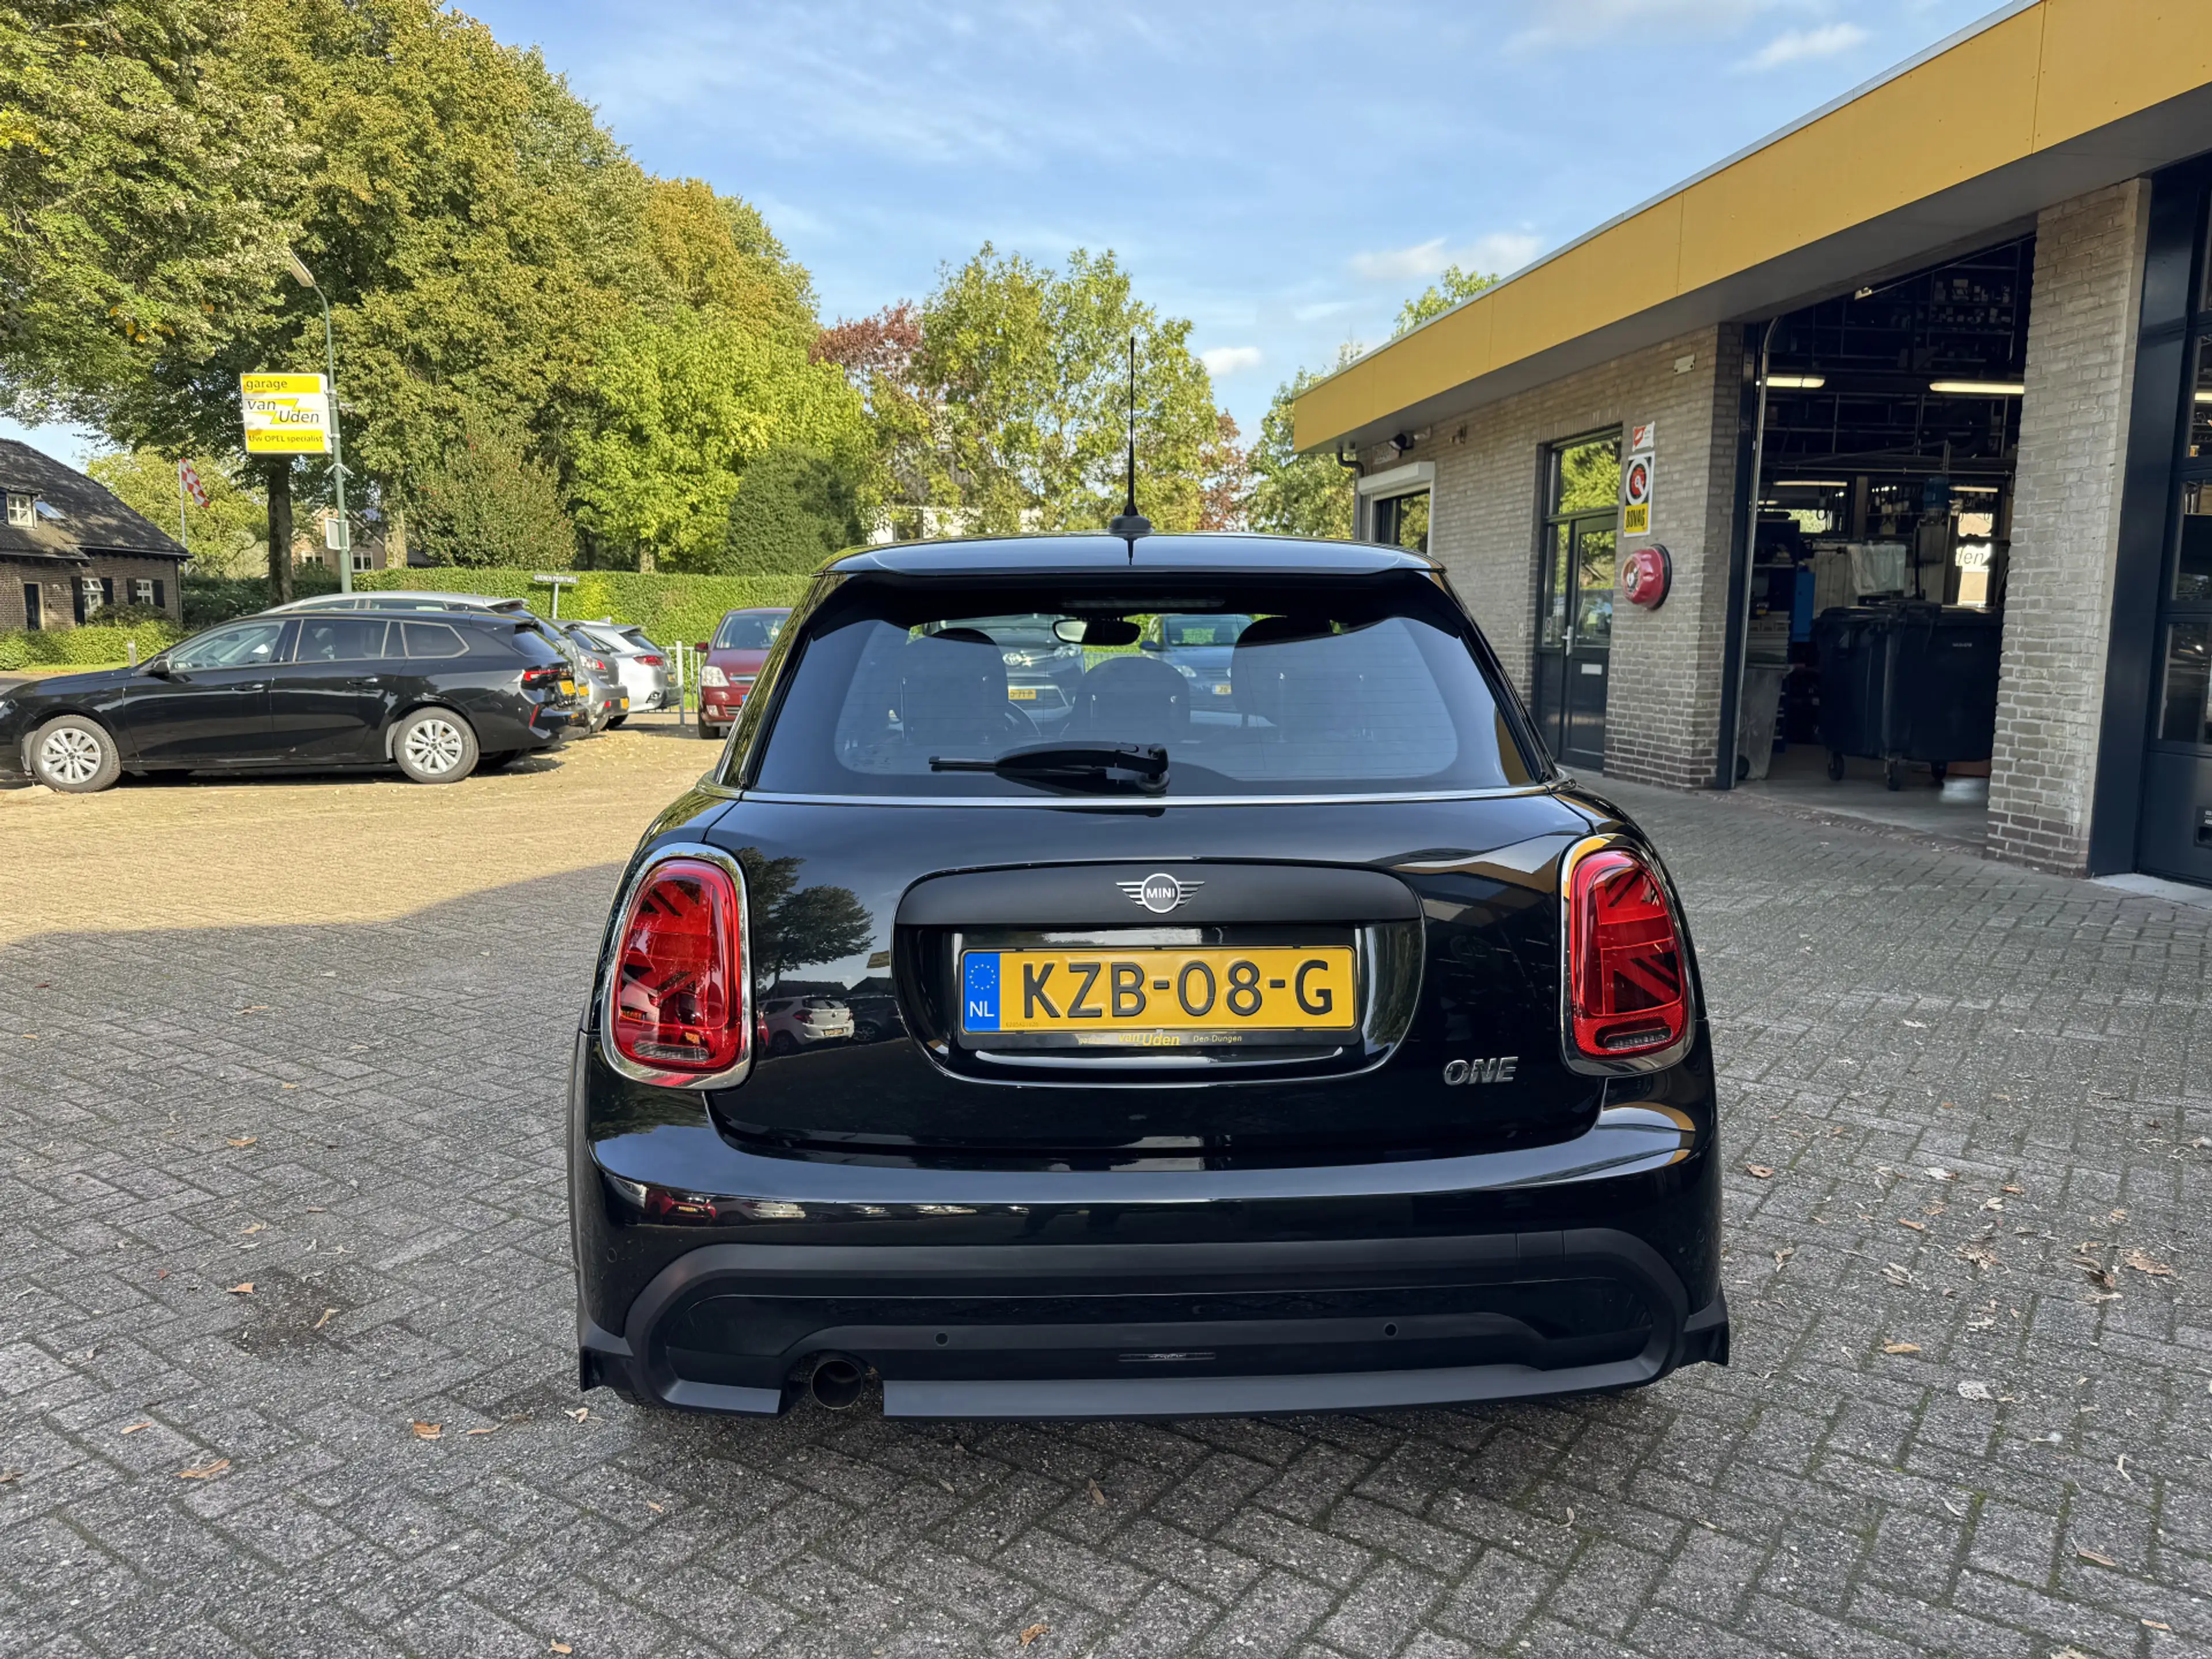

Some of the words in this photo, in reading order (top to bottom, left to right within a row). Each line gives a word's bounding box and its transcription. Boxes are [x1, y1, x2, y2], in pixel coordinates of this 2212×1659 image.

[246, 380, 287, 390] garage
[248, 400, 276, 410] van
[279, 410, 319, 423] Uden
[287, 435, 323, 443] specialist
[1146, 888, 1175, 898] MINI
[1023, 959, 1333, 1018] KZB-08-G
[969, 1001, 995, 1017] NL
[1119, 1034, 1139, 1043] van
[1142, 1032, 1180, 1046] Uden
[1212, 1034, 1243, 1043] Dungen
[1443, 1056, 1519, 1086] ONE
